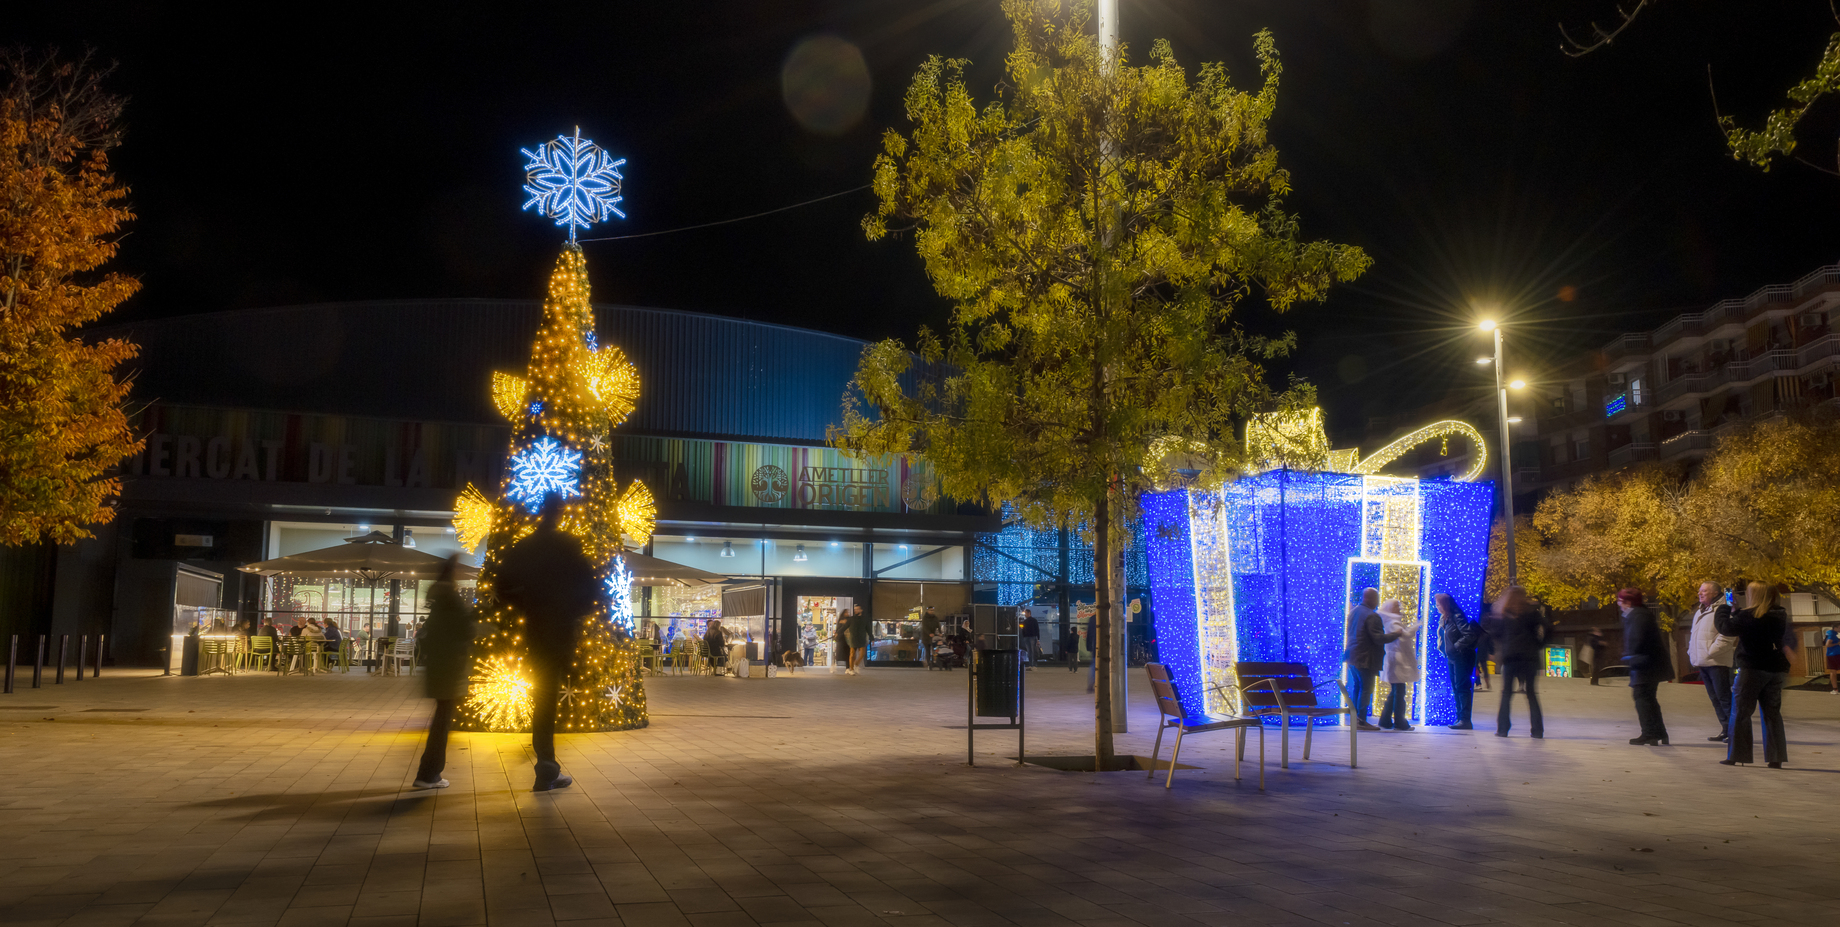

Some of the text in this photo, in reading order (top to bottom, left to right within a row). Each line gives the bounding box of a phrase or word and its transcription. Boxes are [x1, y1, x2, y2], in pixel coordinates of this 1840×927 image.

[307, 441, 358, 485] DE
[385, 446, 432, 488] LA
[799, 467, 888, 484] AMETLLER
[798, 483, 889, 507] ORIGEN
